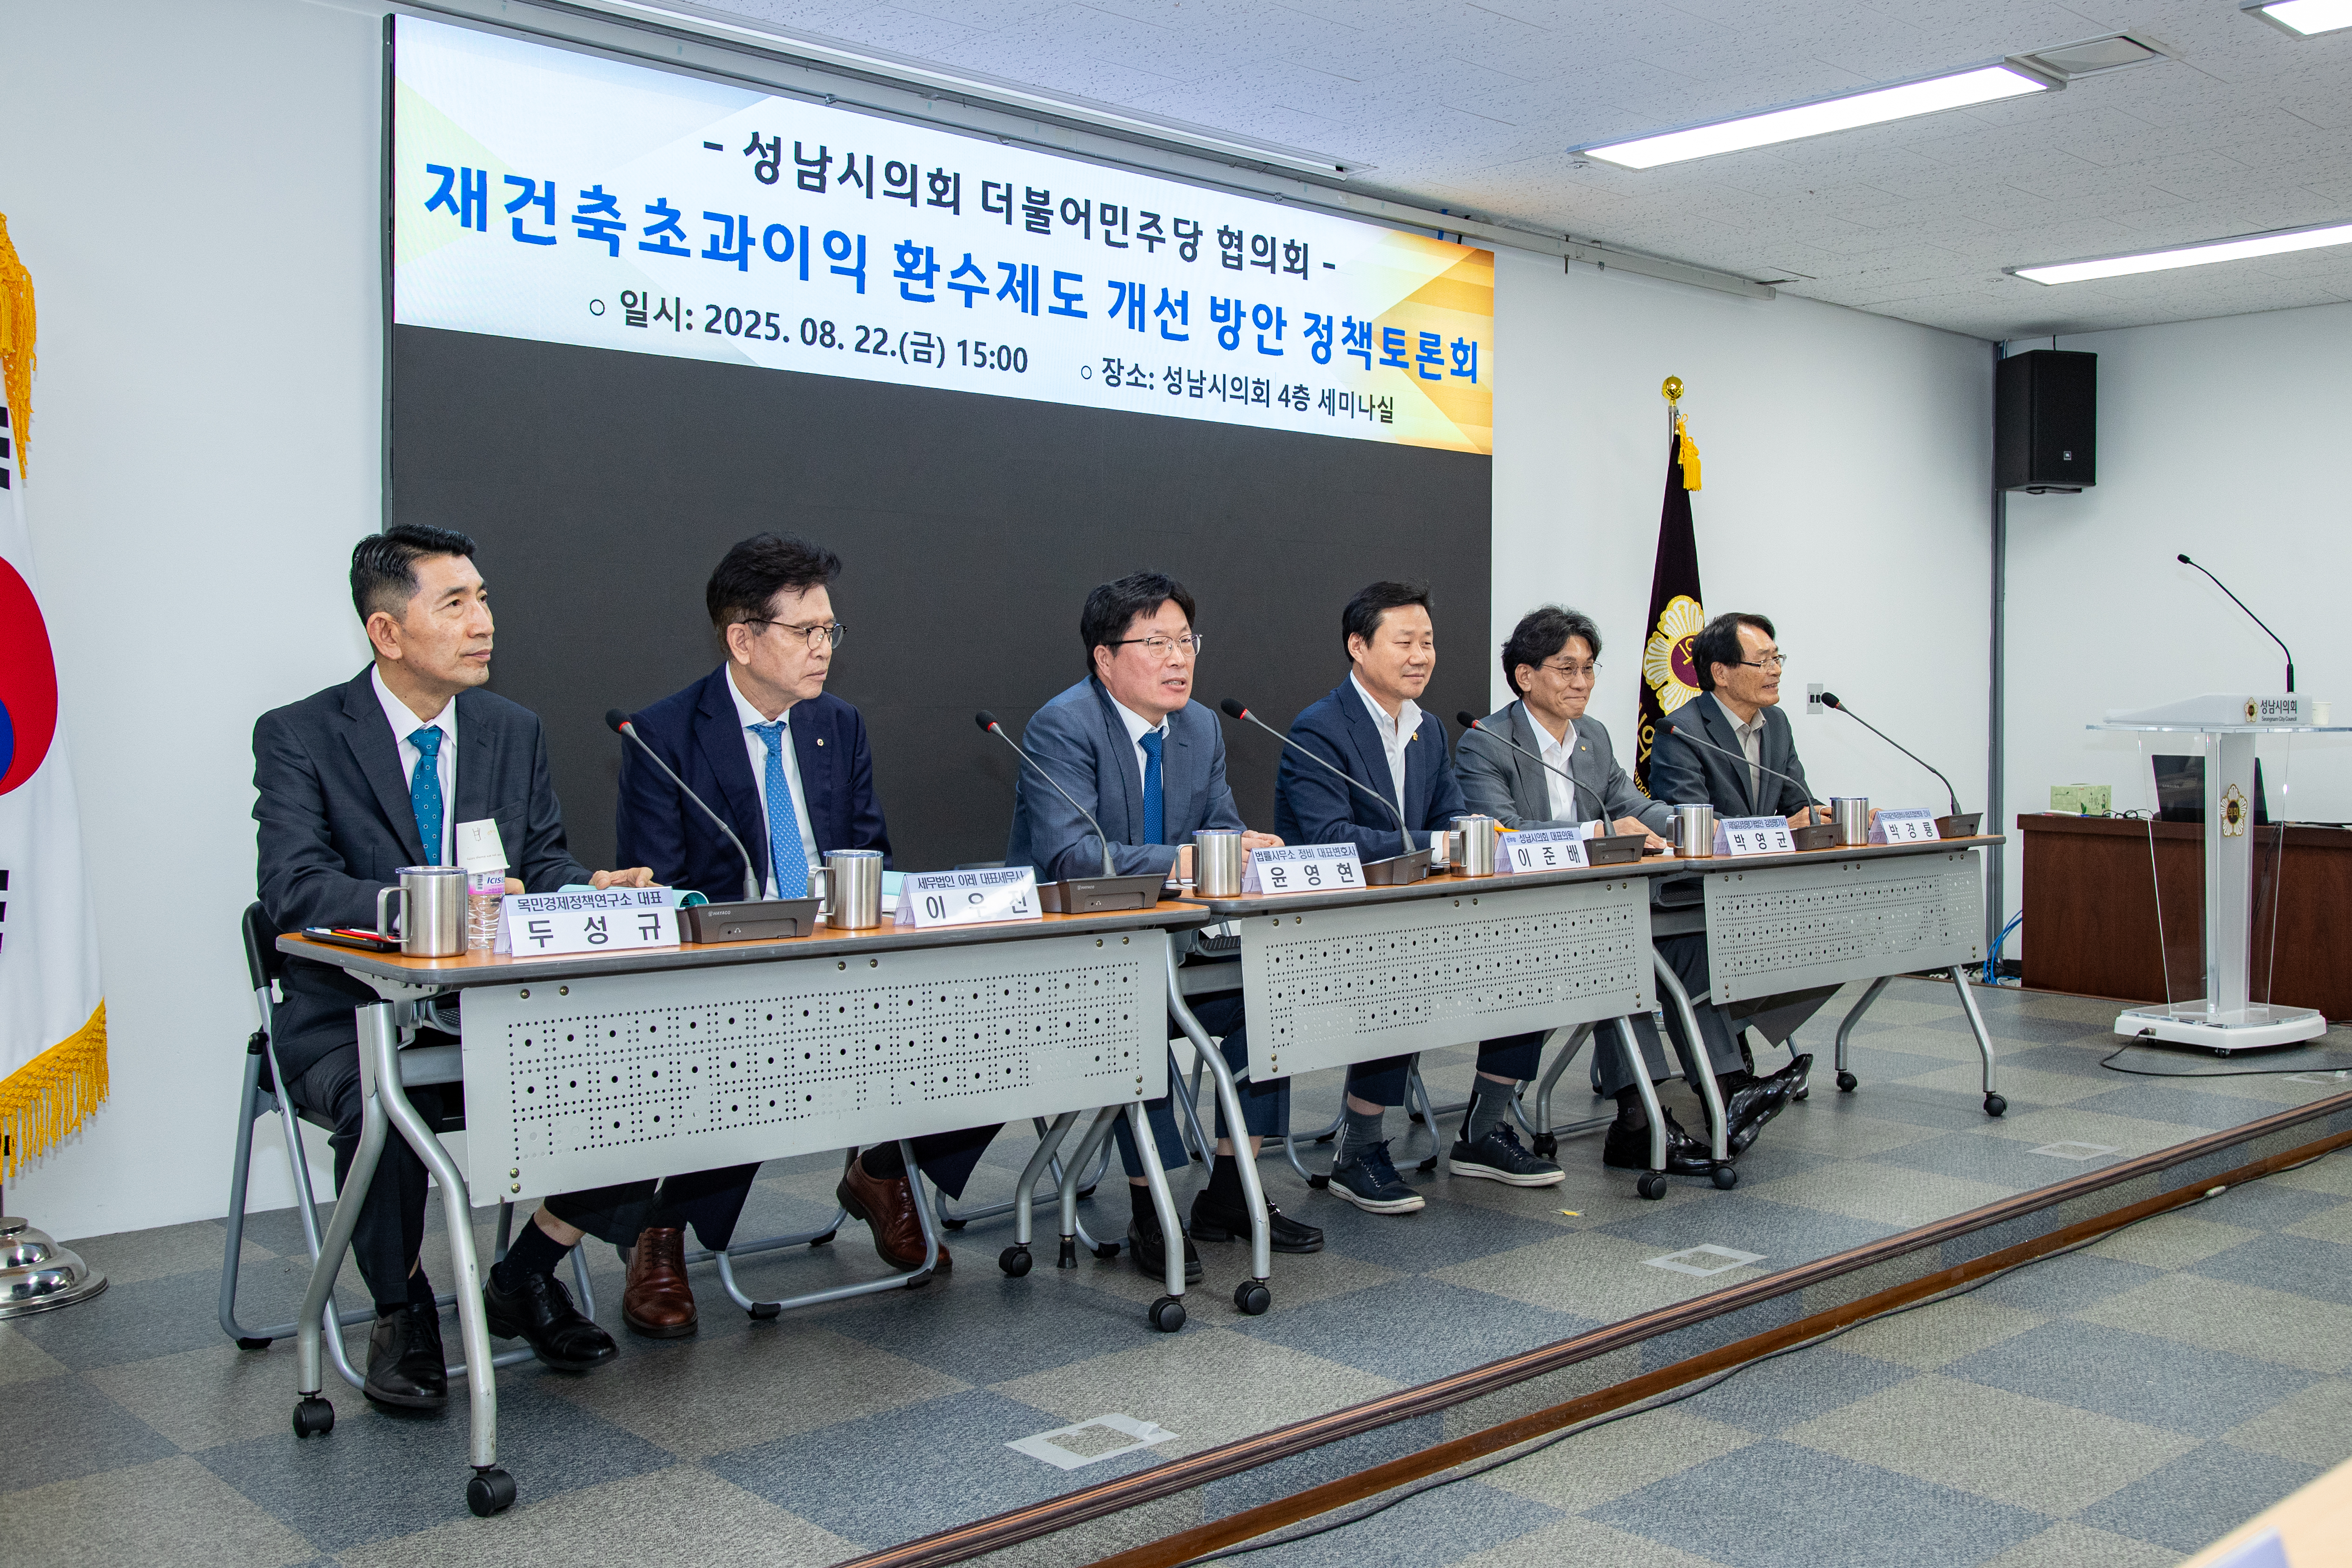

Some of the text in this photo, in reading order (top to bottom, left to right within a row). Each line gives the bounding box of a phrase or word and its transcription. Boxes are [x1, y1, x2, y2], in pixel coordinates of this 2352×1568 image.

[743, 132, 960, 215] 성남시의회
[982, 180, 1203, 263] 더불어민주당
[1216, 225, 1308, 280] 협의회
[424, 163, 1478, 384] 재건축초과이익 환수제도 개선 방안 정책토론회
[621, 290, 693, 332] 일시:
[705, 304, 789, 342] 2025.
[801, 317, 844, 349] 08.
[958, 340, 1028, 373] 15:00
[1102, 357, 1393, 424] 장소: 성남시의회 4층 세미나실
[2260, 699, 2297, 714] 성남시의회
[2228, 807, 2238, 818] 의회
[1764, 818, 1787, 827] 감정평가사
[1519, 832, 1549, 844] 성남시의회
[1550, 830, 1575, 841] 대표의원
[1255, 846, 1356, 862] 법률사무소 정비 대표변호사
[918, 870, 1024, 889] 세무법인 이레 대표세무사
[517, 891, 663, 912] 목민경제정책연구소 대표
